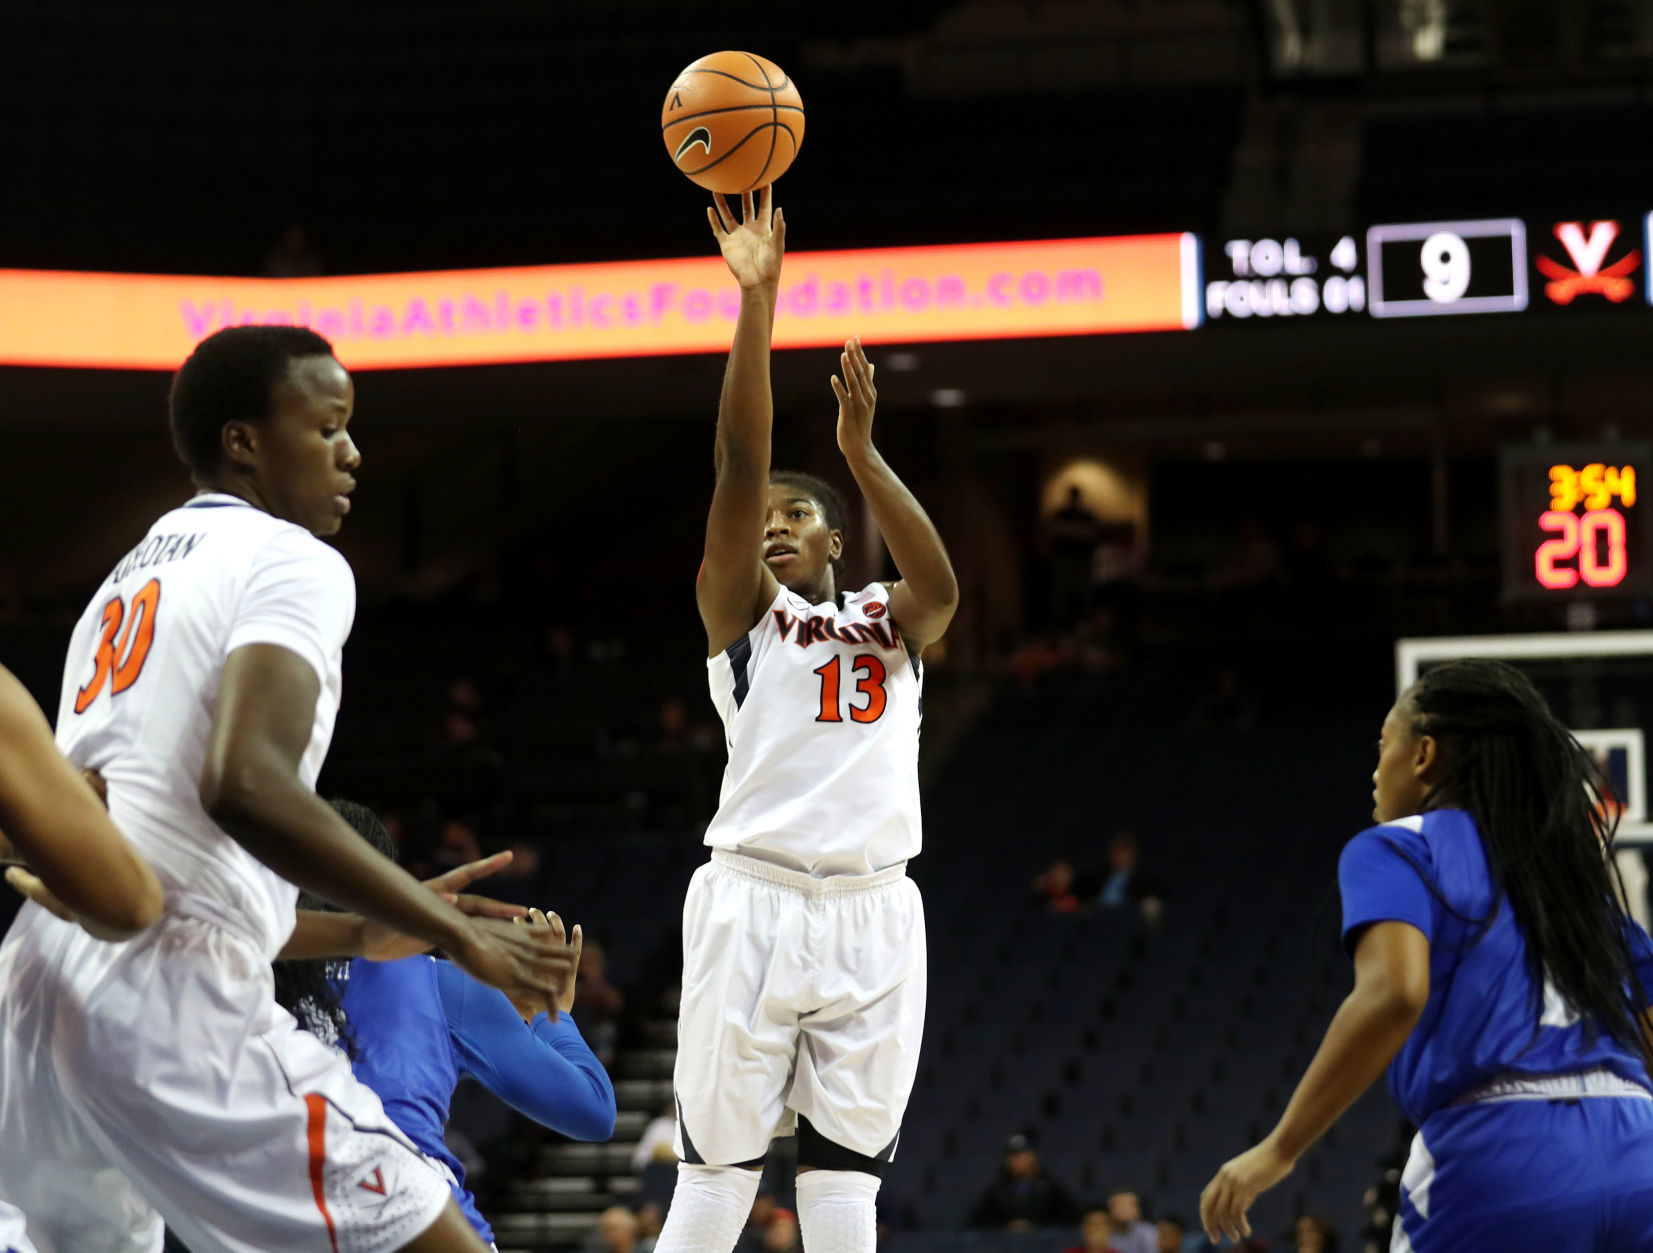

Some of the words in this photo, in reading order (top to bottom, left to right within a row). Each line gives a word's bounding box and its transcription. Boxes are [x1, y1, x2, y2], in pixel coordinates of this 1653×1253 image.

[1330, 235, 1358, 273] 4
[1420, 231, 1471, 304] 9
[1205, 276, 1319, 319] FOULS
[1323, 274, 1366, 314] 01
[1535, 508, 1627, 590] 20
[74, 577, 160, 715] 30
[813, 654, 888, 724] 13
